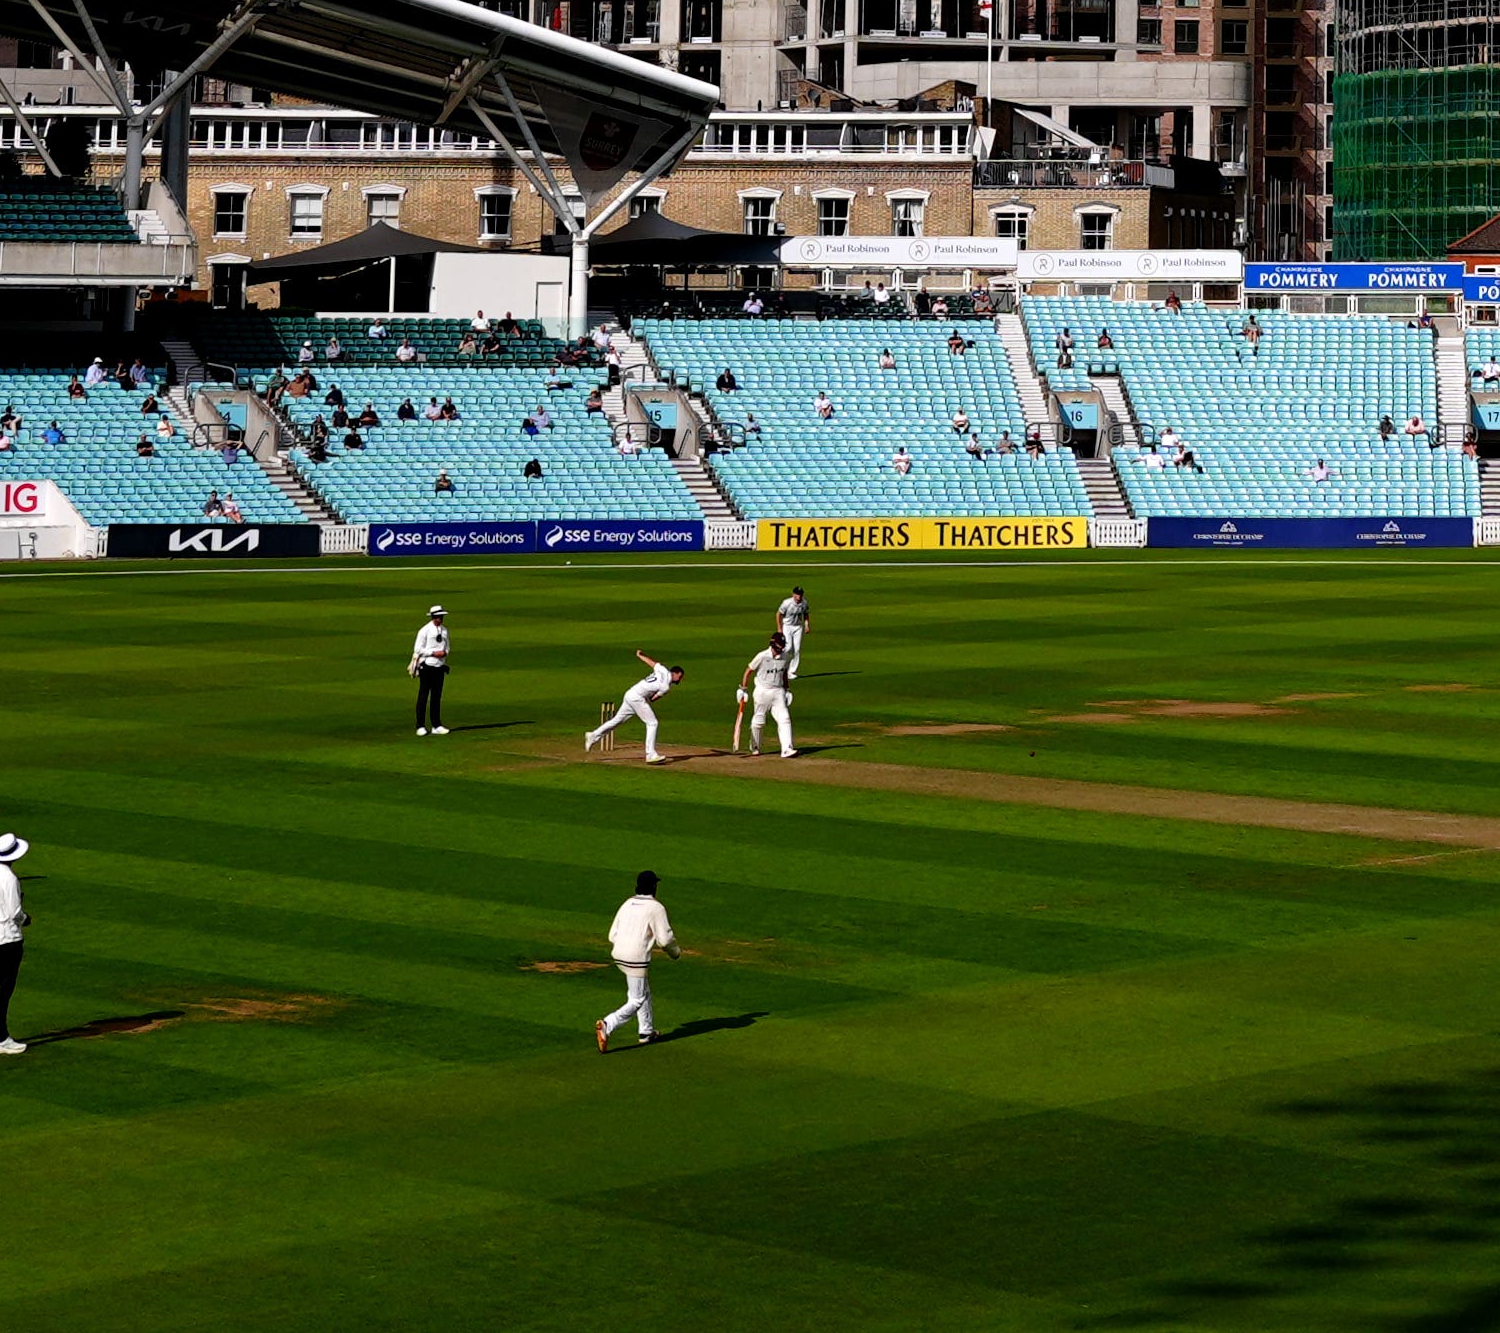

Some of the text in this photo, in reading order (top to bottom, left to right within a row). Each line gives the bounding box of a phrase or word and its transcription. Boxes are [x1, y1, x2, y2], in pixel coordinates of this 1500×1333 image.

[826, 244, 890, 254] Paul Robinson
[1259, 272, 1338, 288] POMMERY
[649, 411, 663, 423] 15
[1069, 411, 1083, 423] 16
[1487, 411, 1500, 423] 17
[396, 531, 524, 548] sse Energy Solutions
[770, 523, 909, 547] THATCHERS
